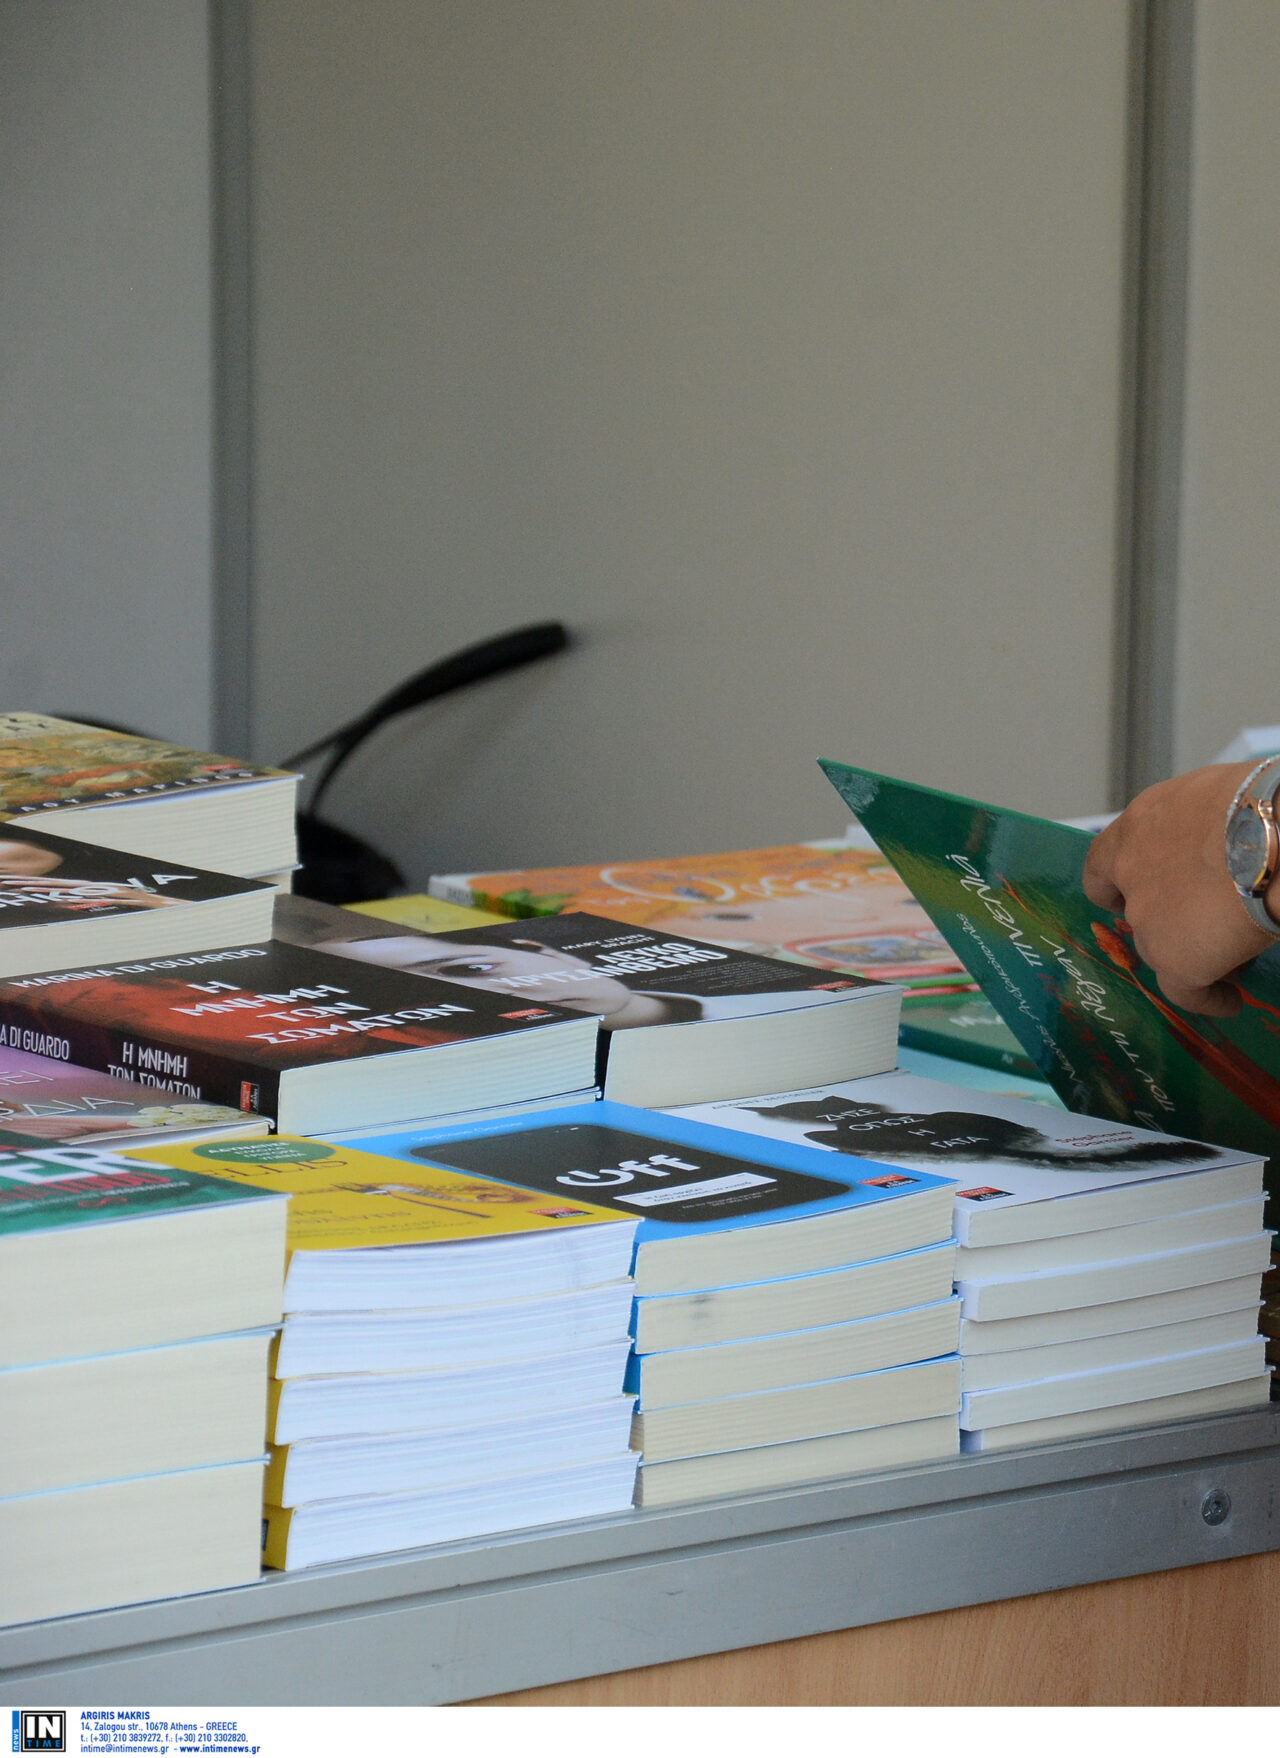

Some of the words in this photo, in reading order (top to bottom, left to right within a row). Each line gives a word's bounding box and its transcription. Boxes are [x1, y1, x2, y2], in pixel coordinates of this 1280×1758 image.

[595, 942, 697, 964] ΛΕΥΚΟ
[8, 969, 124, 989] MARINA
[119, 964, 153, 975] DI
[149, 949, 268, 970] GUARDO
[169, 984, 350, 1017] ΜΝΗΜΗ
[186, 980, 242, 994] Η
[245, 1003, 476, 1045] ΣΩΜΑΤΩΝ
[256, 1001, 372, 1023] ΤΩΝ
[9, 1030, 22, 1050] DI
[22, 1030, 71, 1061] GUARDO
[122, 1041, 134, 1064] Η
[138, 1046, 189, 1078] ΜΝΗΜΗ
[929, 1134, 990, 1149] ΓΑΤΑ
